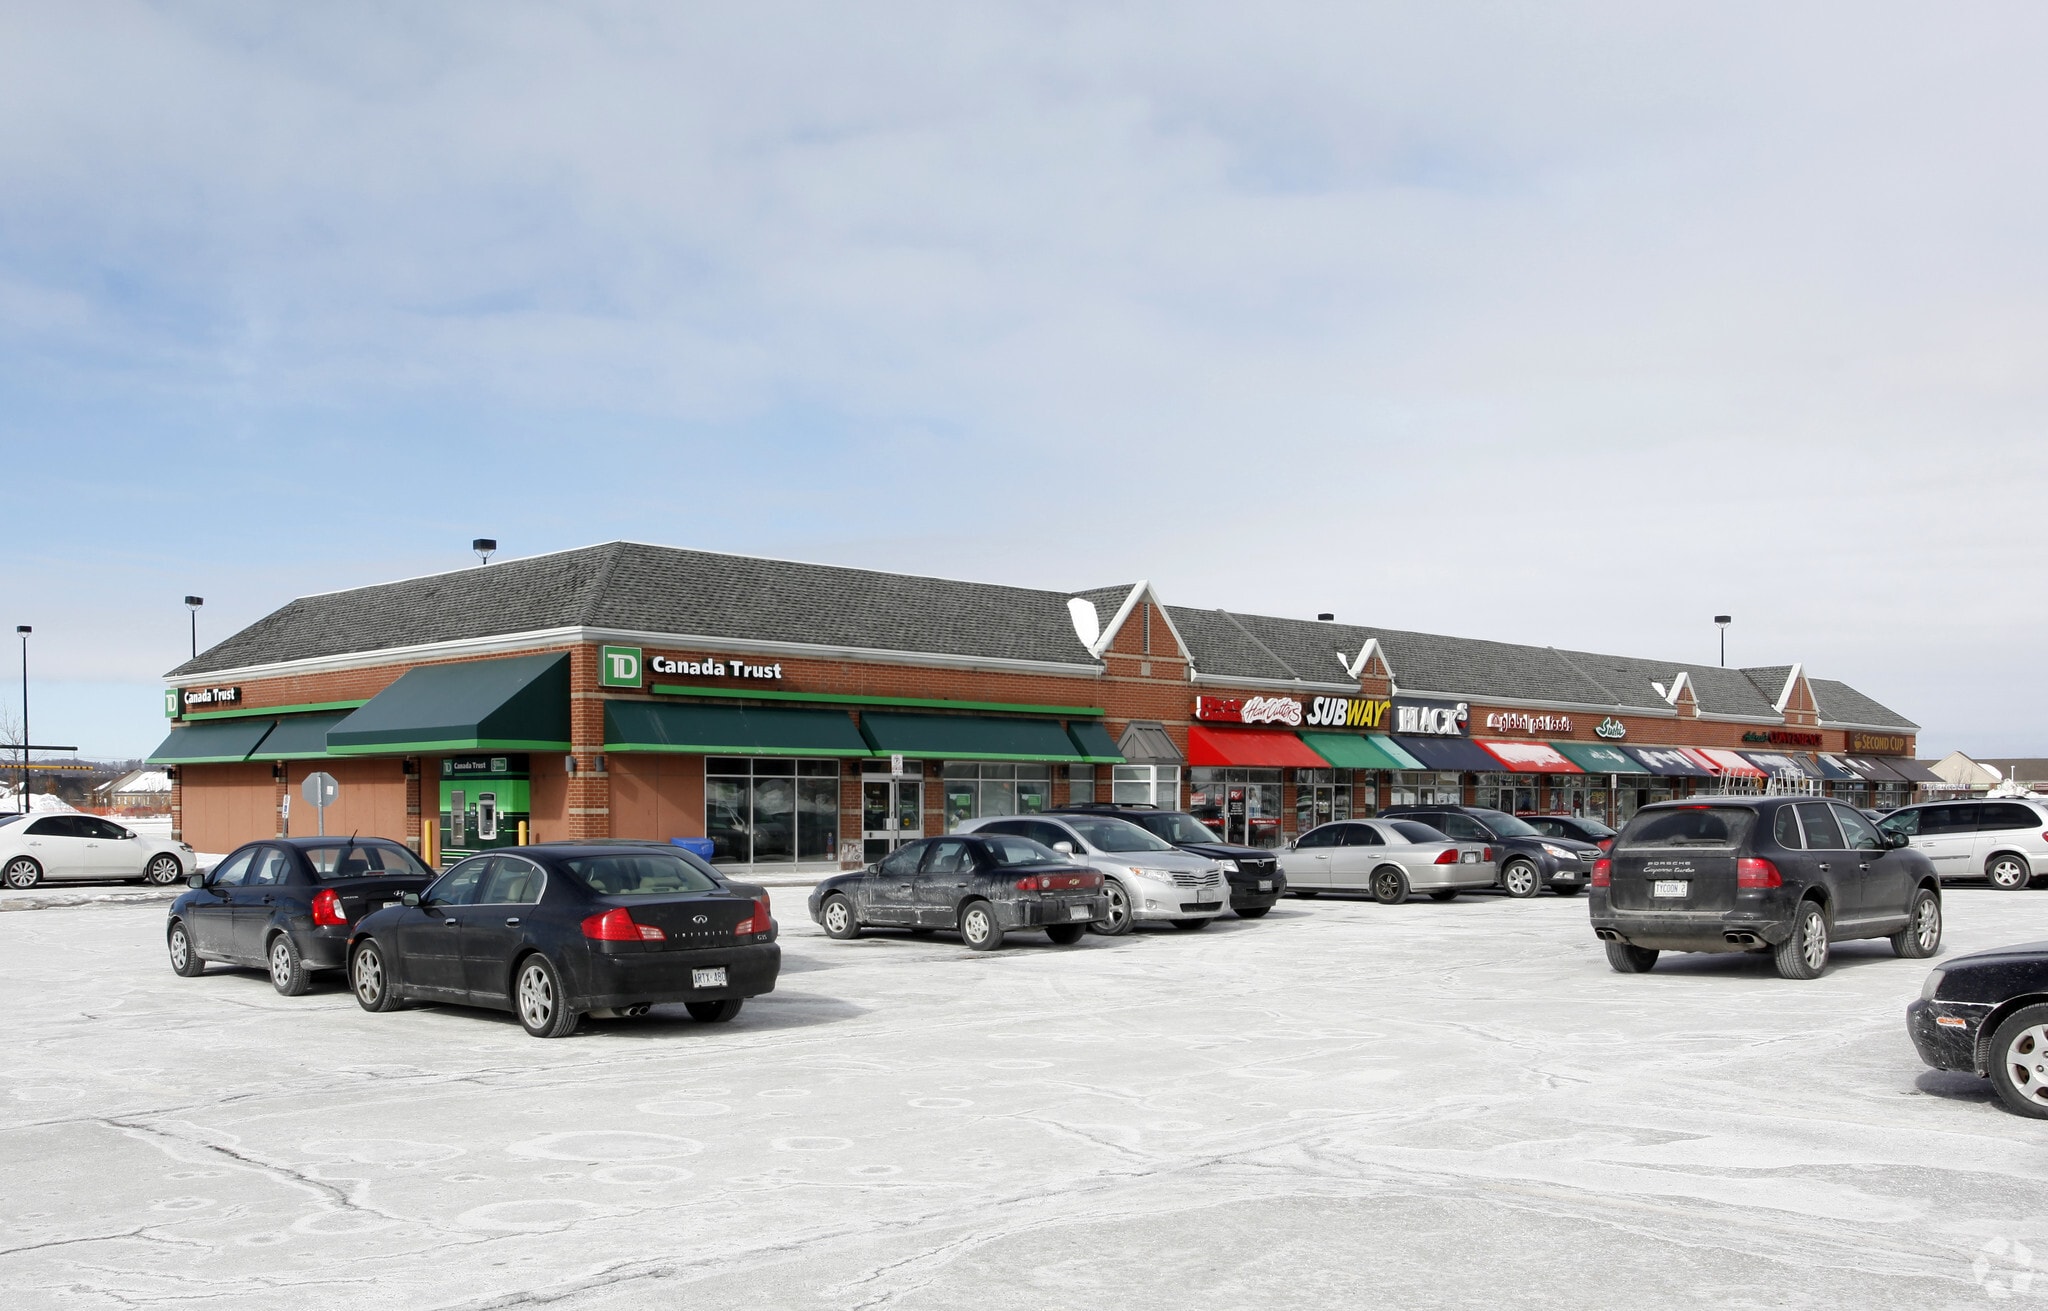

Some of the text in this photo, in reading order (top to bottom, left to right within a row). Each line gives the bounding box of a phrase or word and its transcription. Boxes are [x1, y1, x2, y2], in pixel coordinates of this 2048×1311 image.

[607, 653, 638, 679] TD
[652, 656, 782, 679] Canada Trust
[184, 687, 235, 704] Canada Trust
[1306, 696, 1391, 727] SUBWAY
[1862, 734, 1889, 750] SECOND
[453, 762, 472, 770] Canada
[472, 761, 486, 769] Trust
[1656, 883, 1686, 893] TYCOON 2
